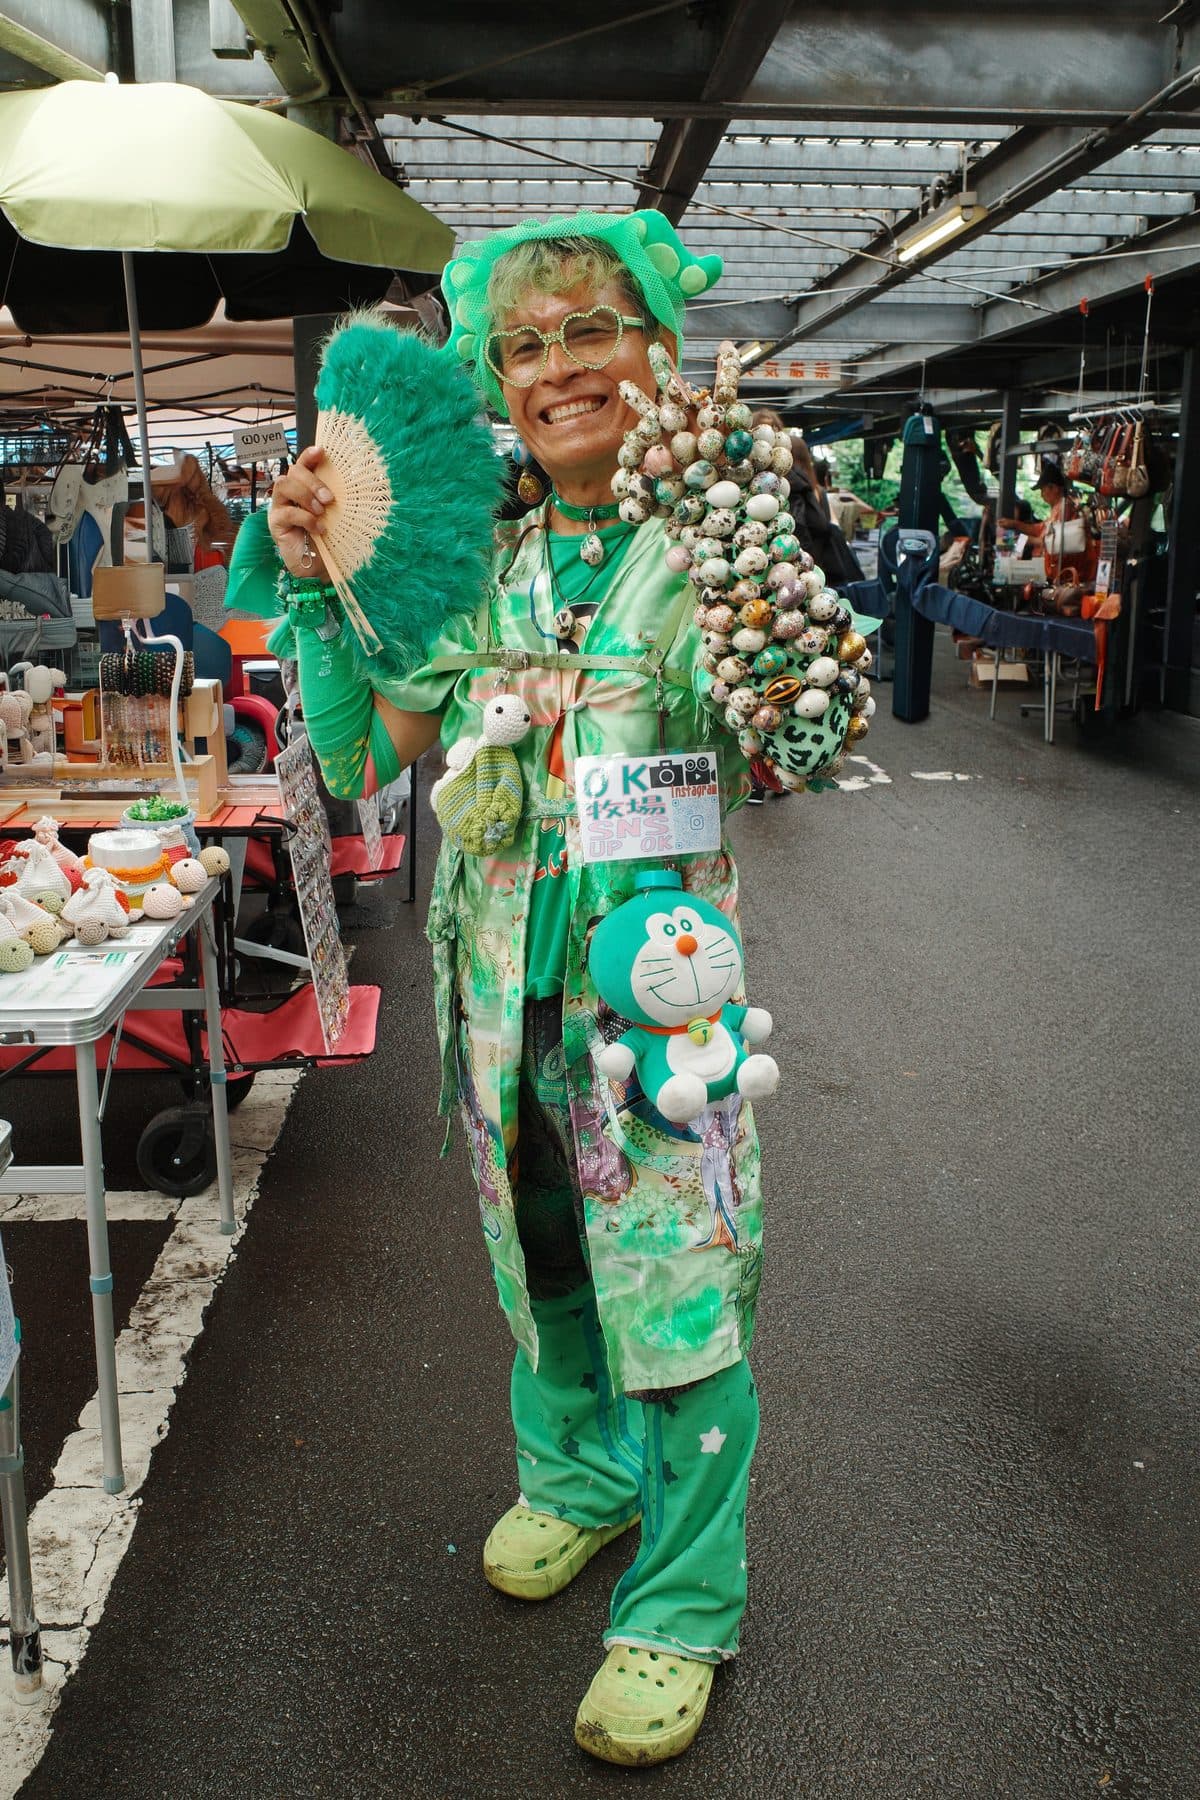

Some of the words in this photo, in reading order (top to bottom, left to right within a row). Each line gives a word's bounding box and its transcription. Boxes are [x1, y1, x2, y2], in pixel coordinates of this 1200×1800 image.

[262, 432, 282, 444] yen
[586, 795, 666, 820] 牧場
[588, 816, 670, 840] SNS
[589, 840, 623, 858] UP
[640, 834, 673, 853] OK
